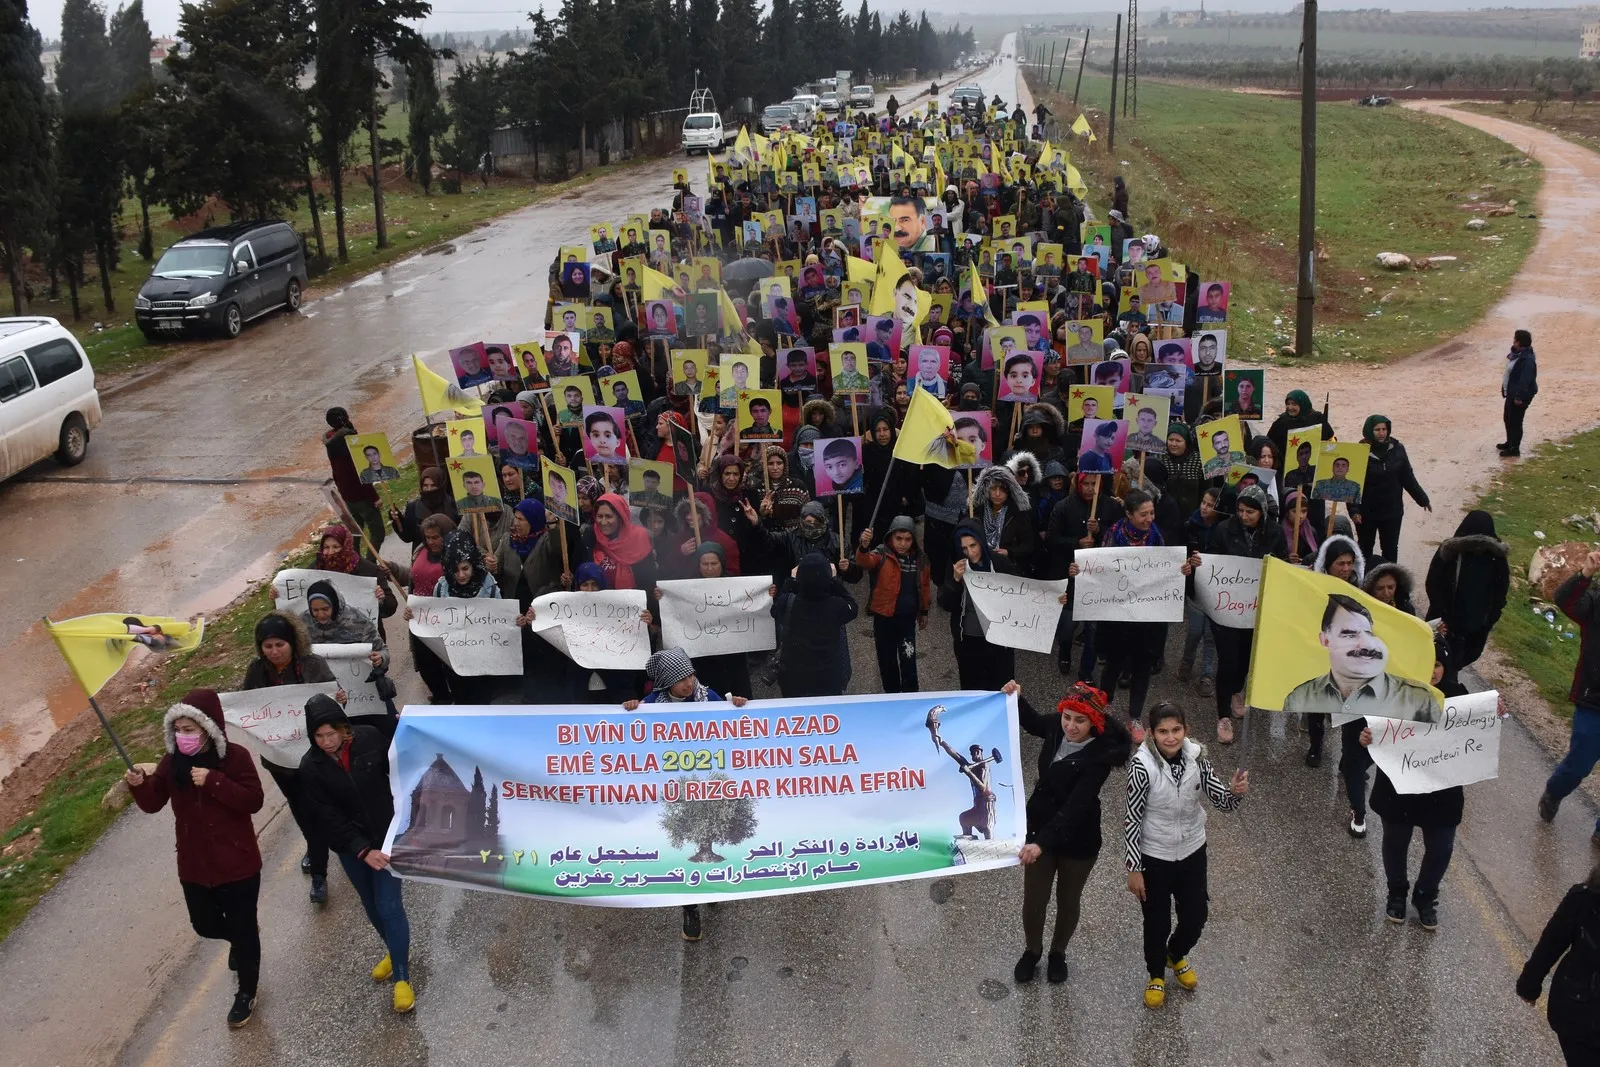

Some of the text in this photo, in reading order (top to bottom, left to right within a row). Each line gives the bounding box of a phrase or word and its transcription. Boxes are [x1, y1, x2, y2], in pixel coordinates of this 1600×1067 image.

[558, 715, 840, 743] BI VÎN Û RAMANÊN AZAD
[1379, 718, 1415, 745] Na
[547, 743, 858, 774] EMÊ SALA 2021 BIKIN SALA
[502, 766, 925, 803] SERKEFTINAN Û RIZGAR KIRINA EFRÎN
[550, 846, 582, 865] عام
[587, 846, 659, 865] سنجعل
[744, 841, 783, 860] الحر
[786, 838, 834, 859] الفكر
[555, 871, 613, 887] عفرين
[616, 868, 684, 887] تحرير
